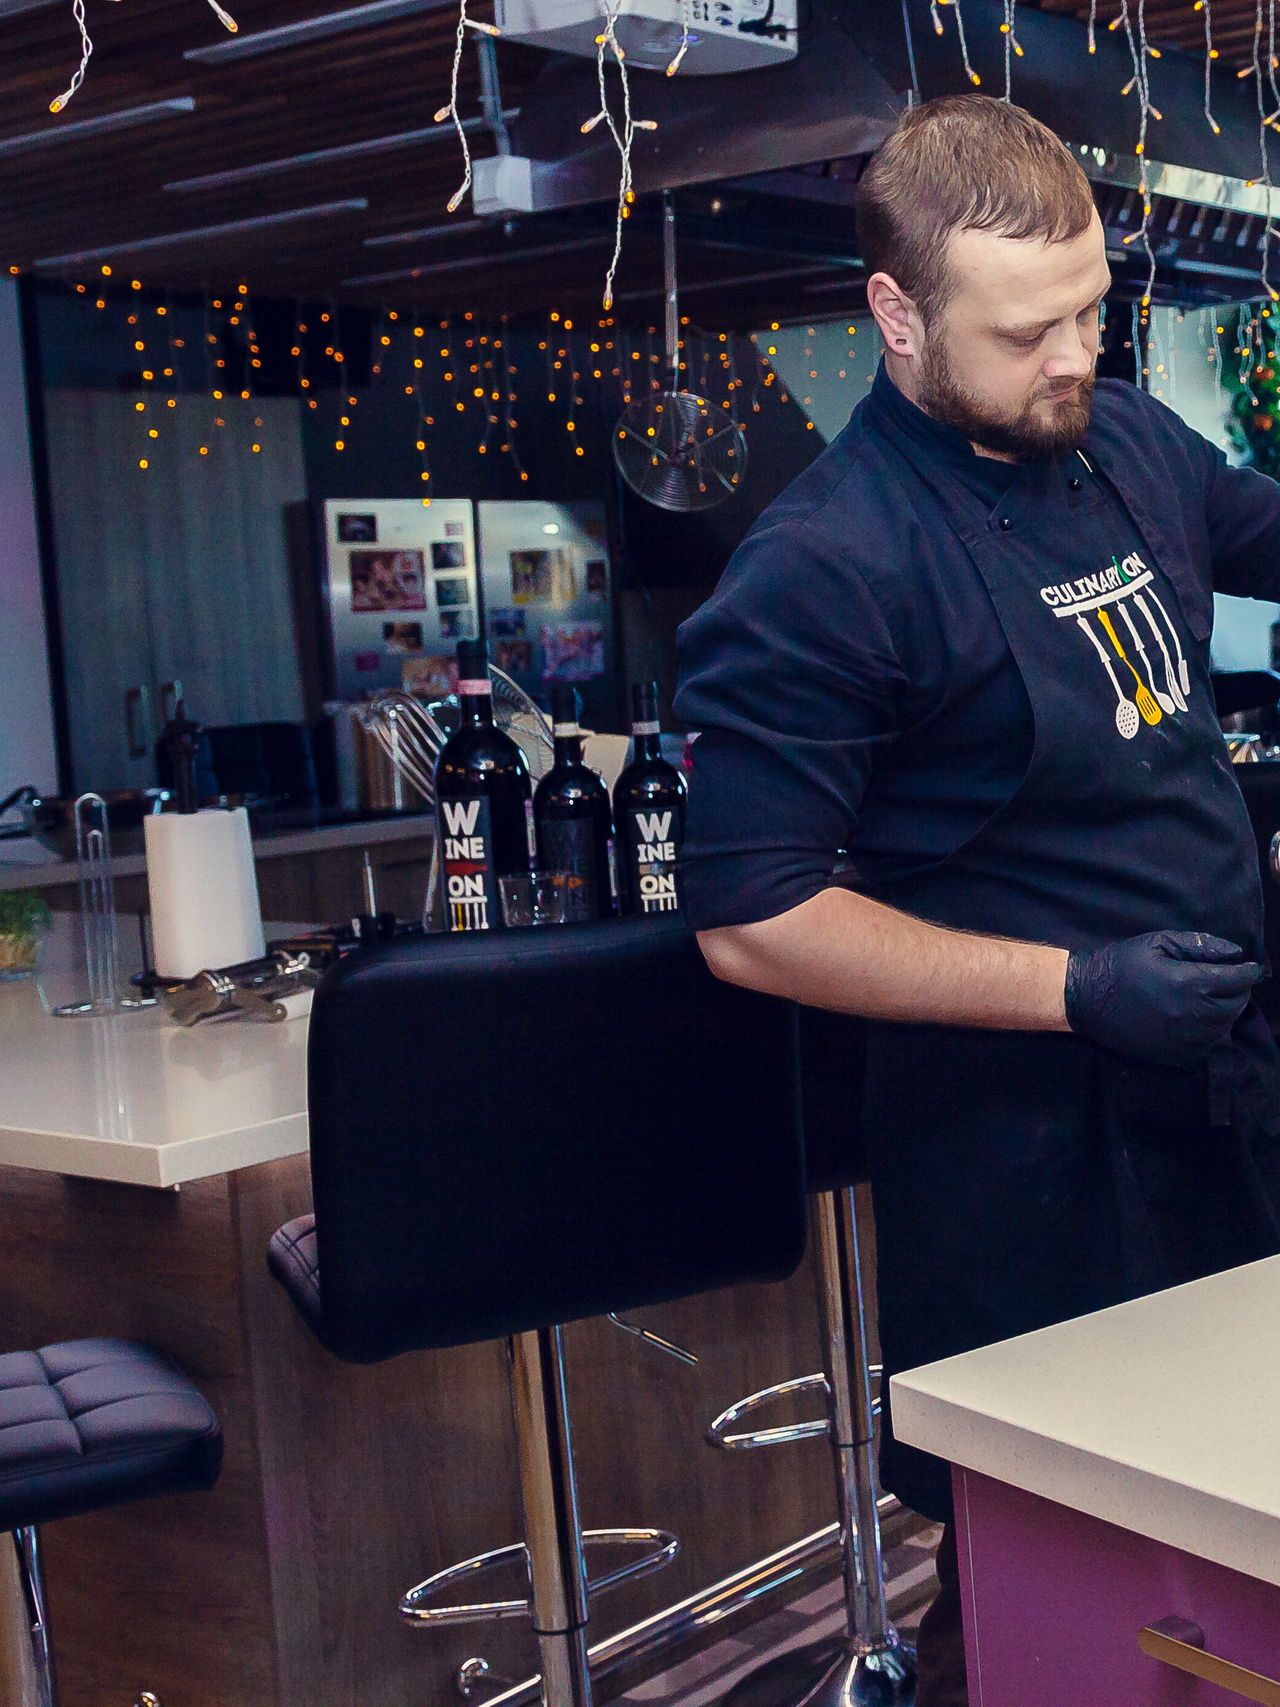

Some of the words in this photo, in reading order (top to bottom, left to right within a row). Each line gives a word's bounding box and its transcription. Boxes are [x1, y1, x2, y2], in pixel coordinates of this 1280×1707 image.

[1040, 564, 1122, 606] CULINARY
[1121, 551, 1147, 578] ON
[448, 873, 484, 898] ON
[640, 872, 676, 895] ON
